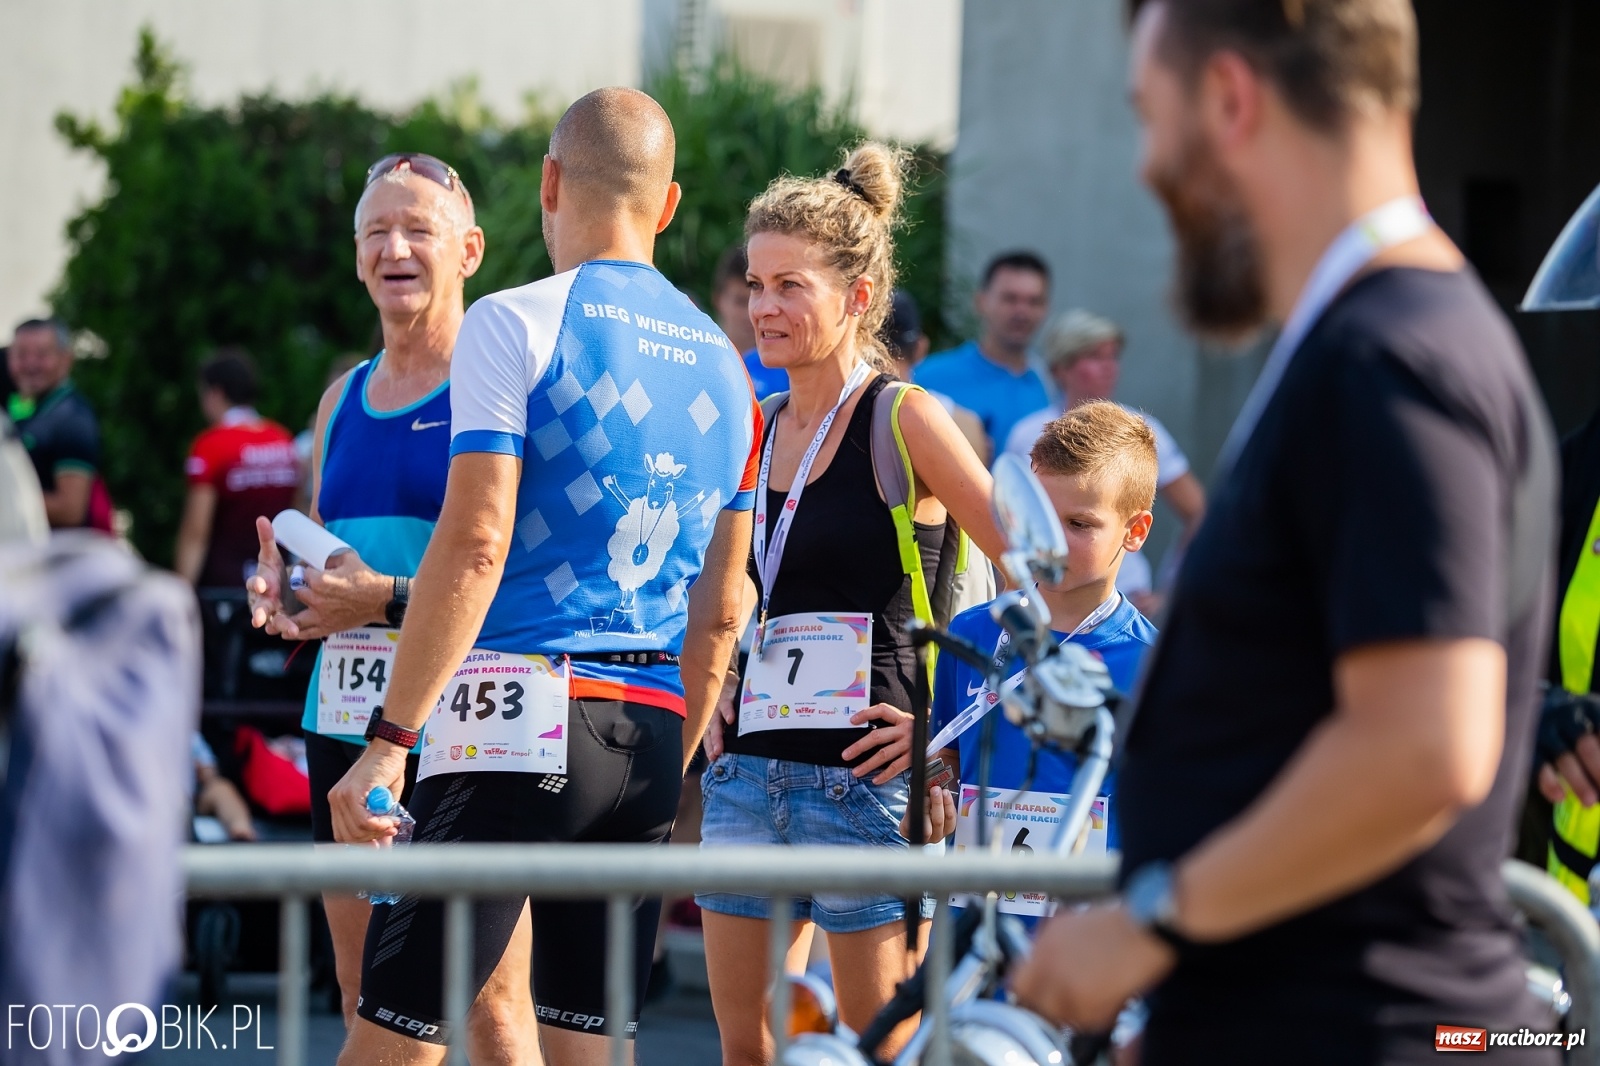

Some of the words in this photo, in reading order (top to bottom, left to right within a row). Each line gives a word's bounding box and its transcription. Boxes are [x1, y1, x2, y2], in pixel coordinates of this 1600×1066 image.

[582, 303, 631, 325] BIEG
[634, 312, 729, 350] WIERCHAMI
[637, 337, 697, 366] RYTRO
[453, 667, 480, 677] RATON
[462, 653, 501, 663] AFAKO
[787, 648, 804, 685] 7
[338, 657, 387, 692] 154
[450, 681, 525, 722] 453
[1014, 803, 1057, 814] RAFAKO
[1011, 827, 1034, 855] 6
[393, 1015, 438, 1036] cep
[560, 1011, 604, 1029] cep
